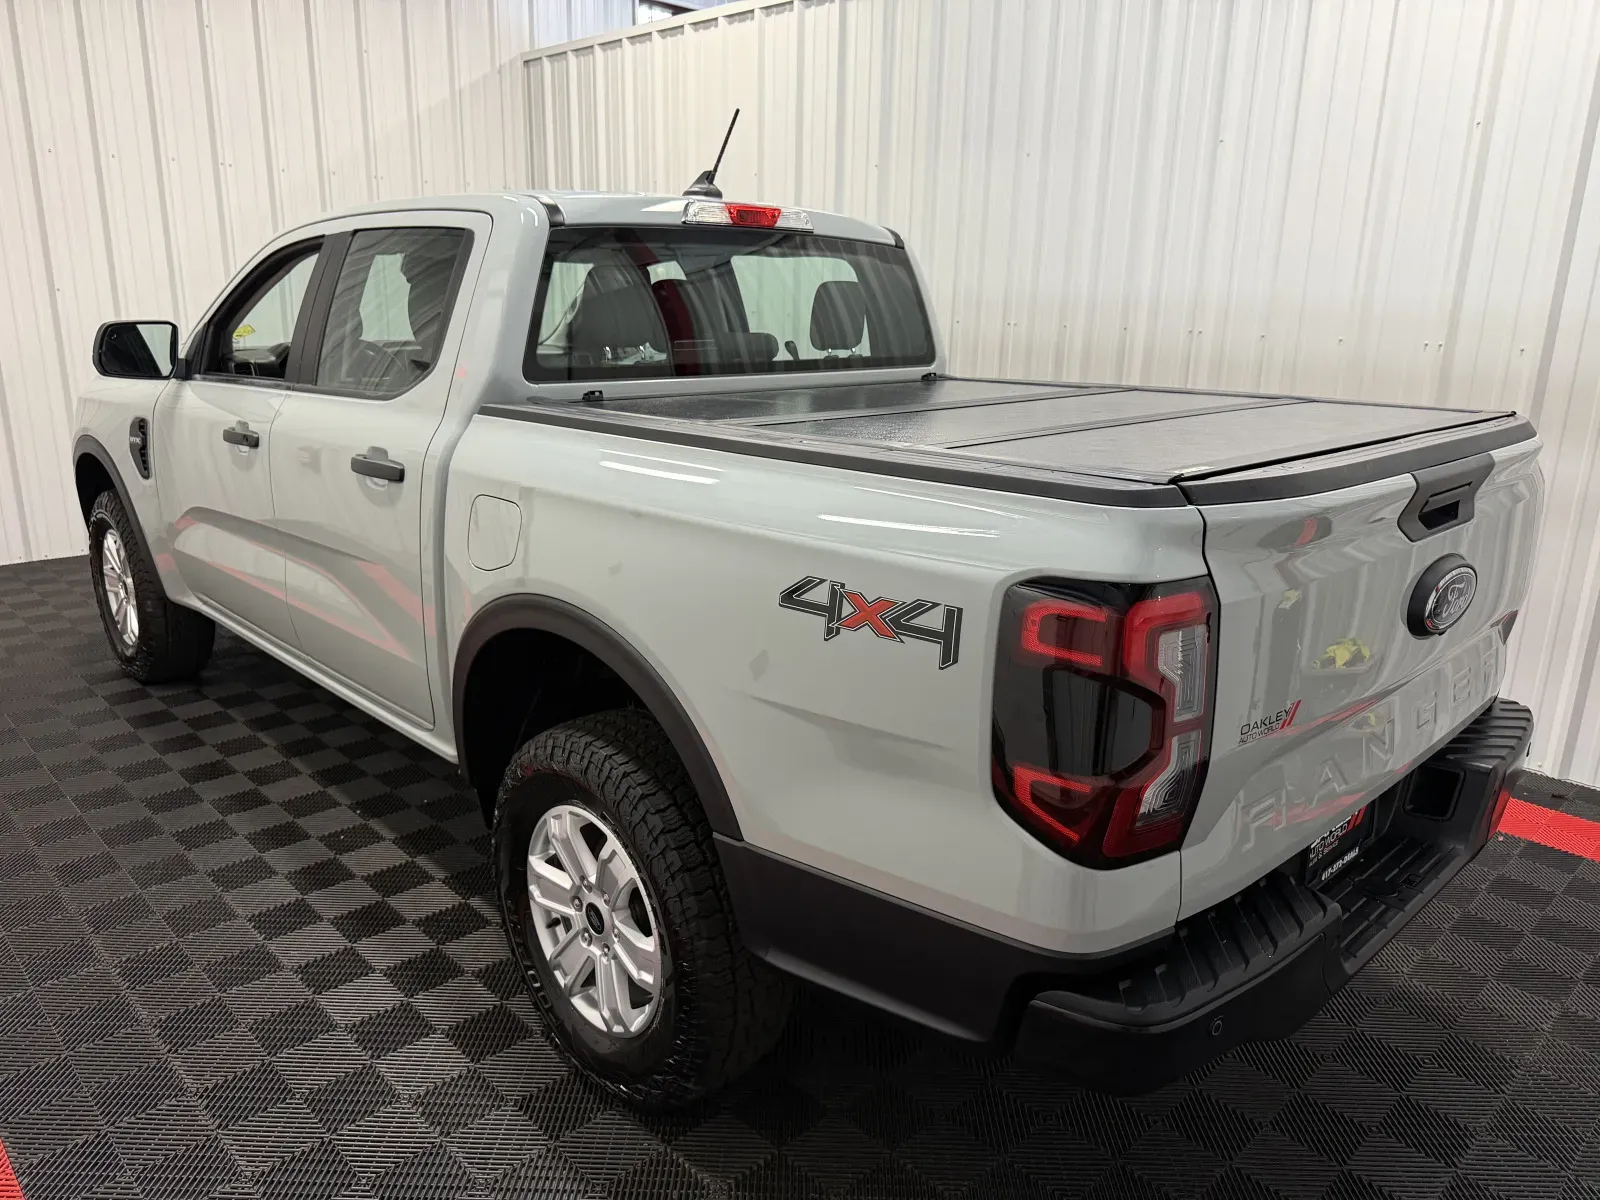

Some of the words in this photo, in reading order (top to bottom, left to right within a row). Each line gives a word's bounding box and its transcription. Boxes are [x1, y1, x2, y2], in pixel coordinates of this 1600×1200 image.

[1442, 581, 1470, 618] Ford
[1239, 731, 1257, 744] AUTO
[1257, 722, 1280, 737] WORLD
[1240, 705, 1291, 736] OAKLEY
[1242, 644, 1500, 852] RANGER
[1325, 822, 1348, 846] WORLD
